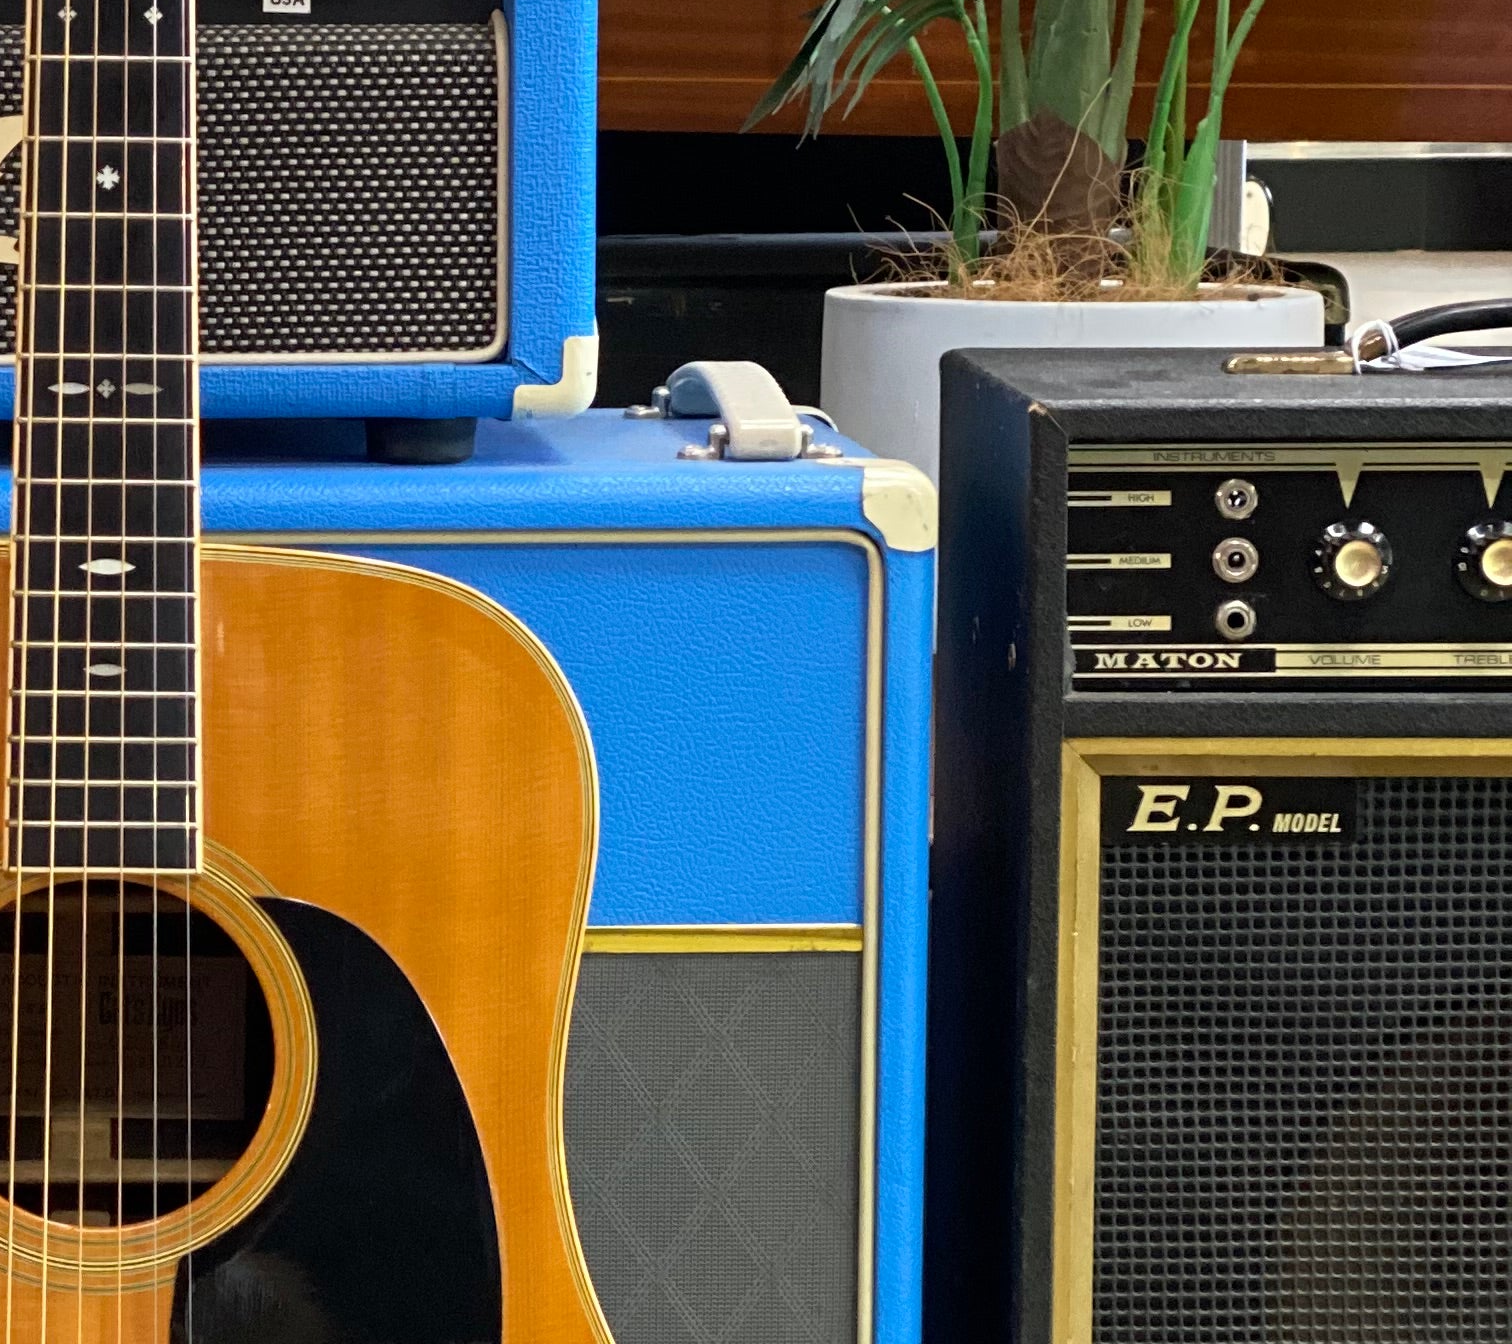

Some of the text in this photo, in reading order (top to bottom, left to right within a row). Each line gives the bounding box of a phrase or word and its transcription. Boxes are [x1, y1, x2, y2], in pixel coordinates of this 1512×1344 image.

[1153, 452, 1276, 462] INSTRUMENTS
[1127, 493, 1155, 502] HIGH
[1119, 557, 1161, 565] MEDIUM
[1128, 619, 1152, 628] LOW
[1094, 653, 1244, 670] MATON
[1308, 654, 1381, 666] VOLUME
[1126, 784, 1343, 834] E.P. MODEL
